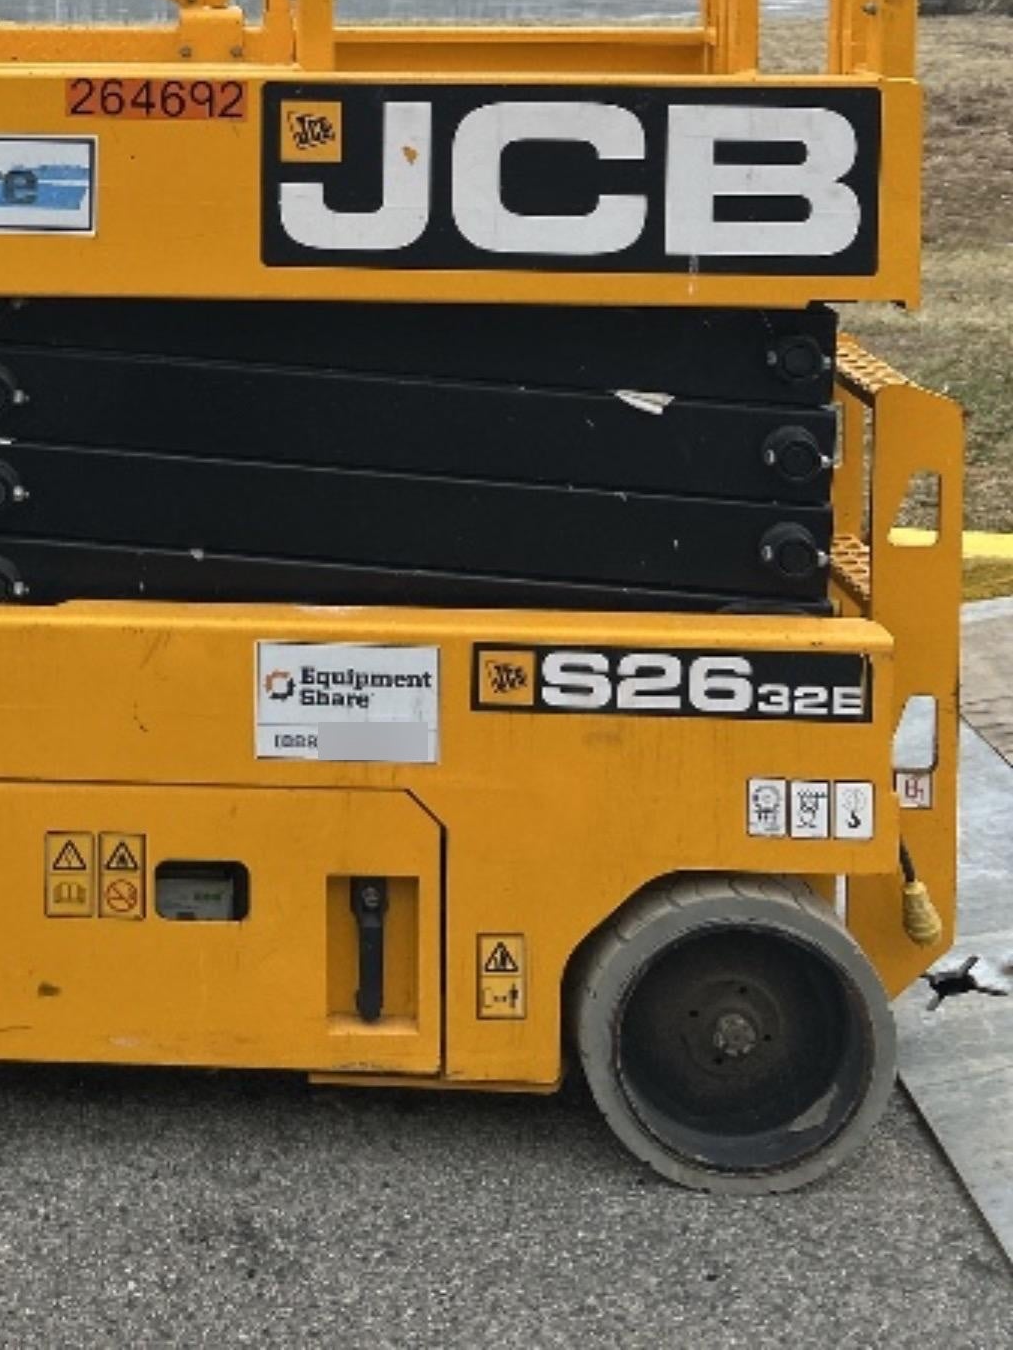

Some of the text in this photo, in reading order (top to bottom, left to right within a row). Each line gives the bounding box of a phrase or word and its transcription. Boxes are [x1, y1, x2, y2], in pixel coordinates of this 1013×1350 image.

[69, 78, 245, 119] 264692
[278, 100, 863, 256] JCB
[299, 665, 433, 691] Equipment
[299, 688, 371, 710] Share
